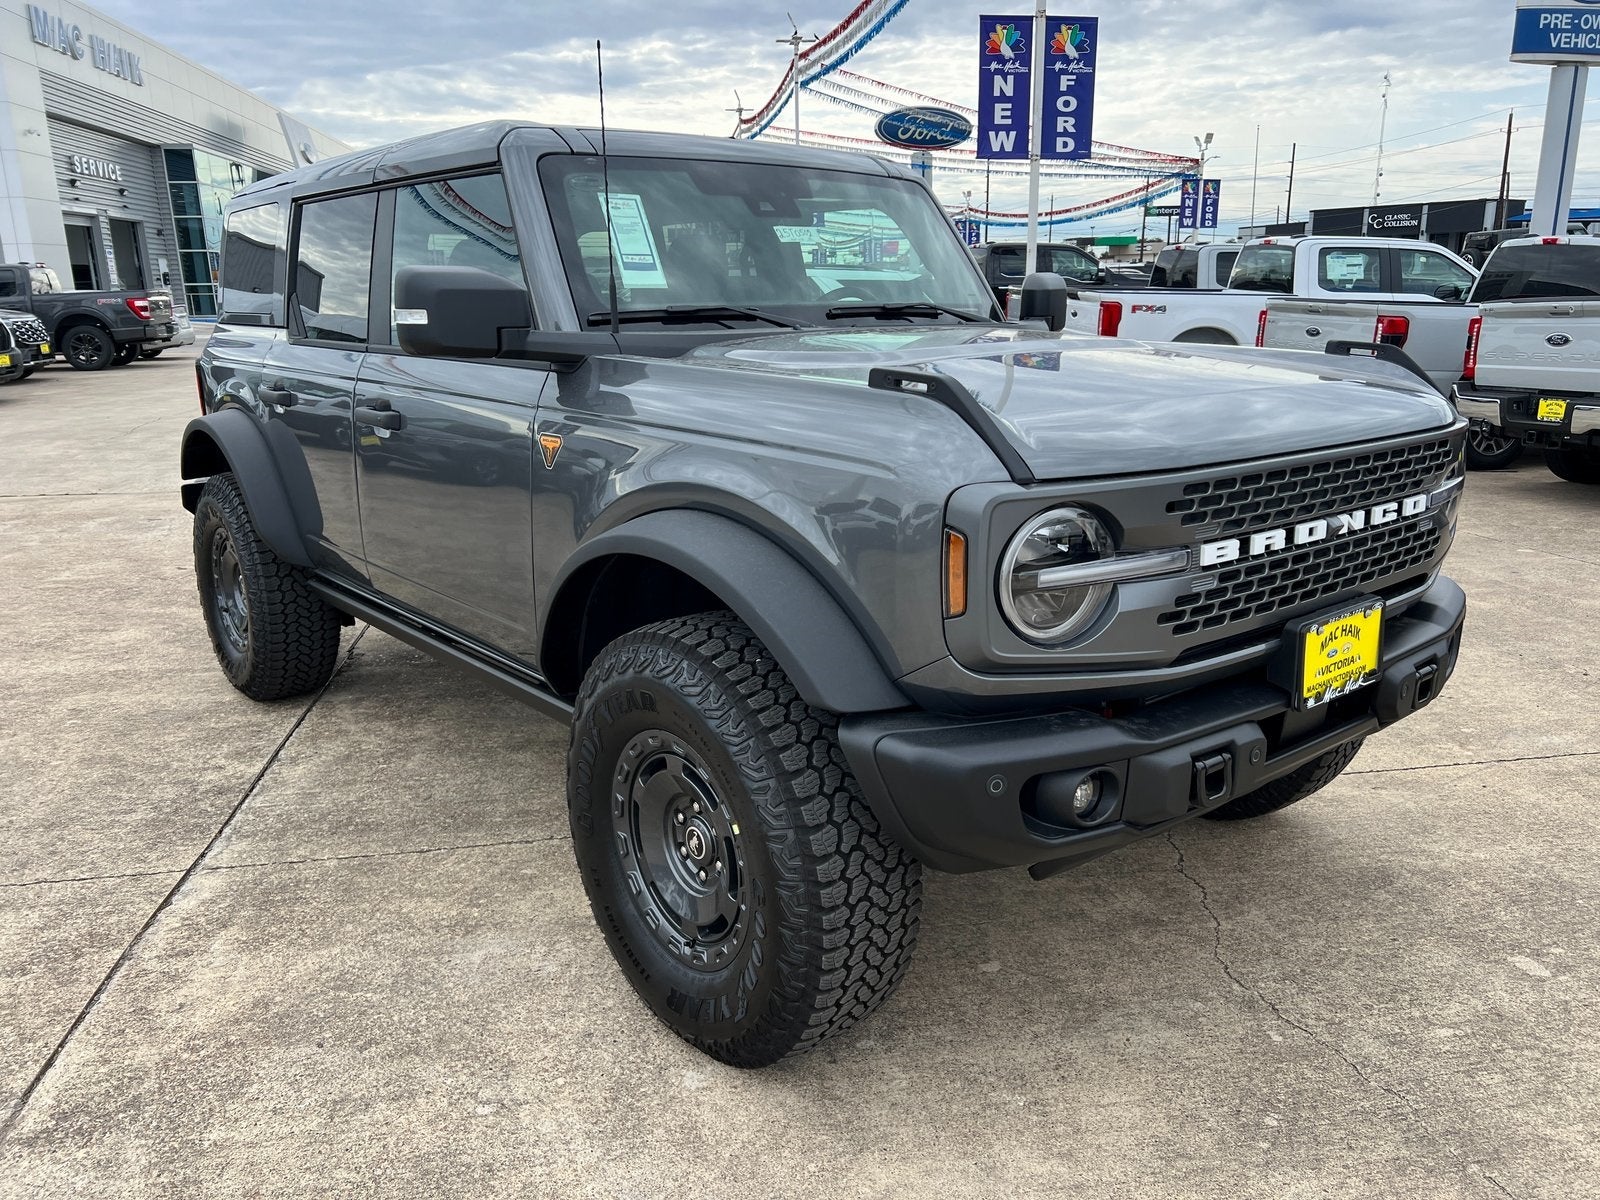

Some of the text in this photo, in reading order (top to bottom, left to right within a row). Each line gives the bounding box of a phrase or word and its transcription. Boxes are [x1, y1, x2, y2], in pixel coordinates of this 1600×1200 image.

[28, 4, 144, 87] MAC HAIK
[988, 74, 1017, 152] NEW
[1055, 74, 1078, 153] FORD
[897, 114, 955, 141] Ford
[73, 155, 122, 181] SERVICE
[1149, 206, 1180, 216] enterp
[1182, 198, 1194, 226] NEW
[1204, 198, 1214, 227] FORD
[1384, 213, 1411, 221] CLASSIC
[1131, 304, 1167, 314] FX4
[1484, 351, 1562, 363] SUPER
[1199, 493, 1427, 567] BRONCO
[1319, 623, 1361, 655] MAC HAIK
[1321, 655, 1355, 676] VICTORIA
